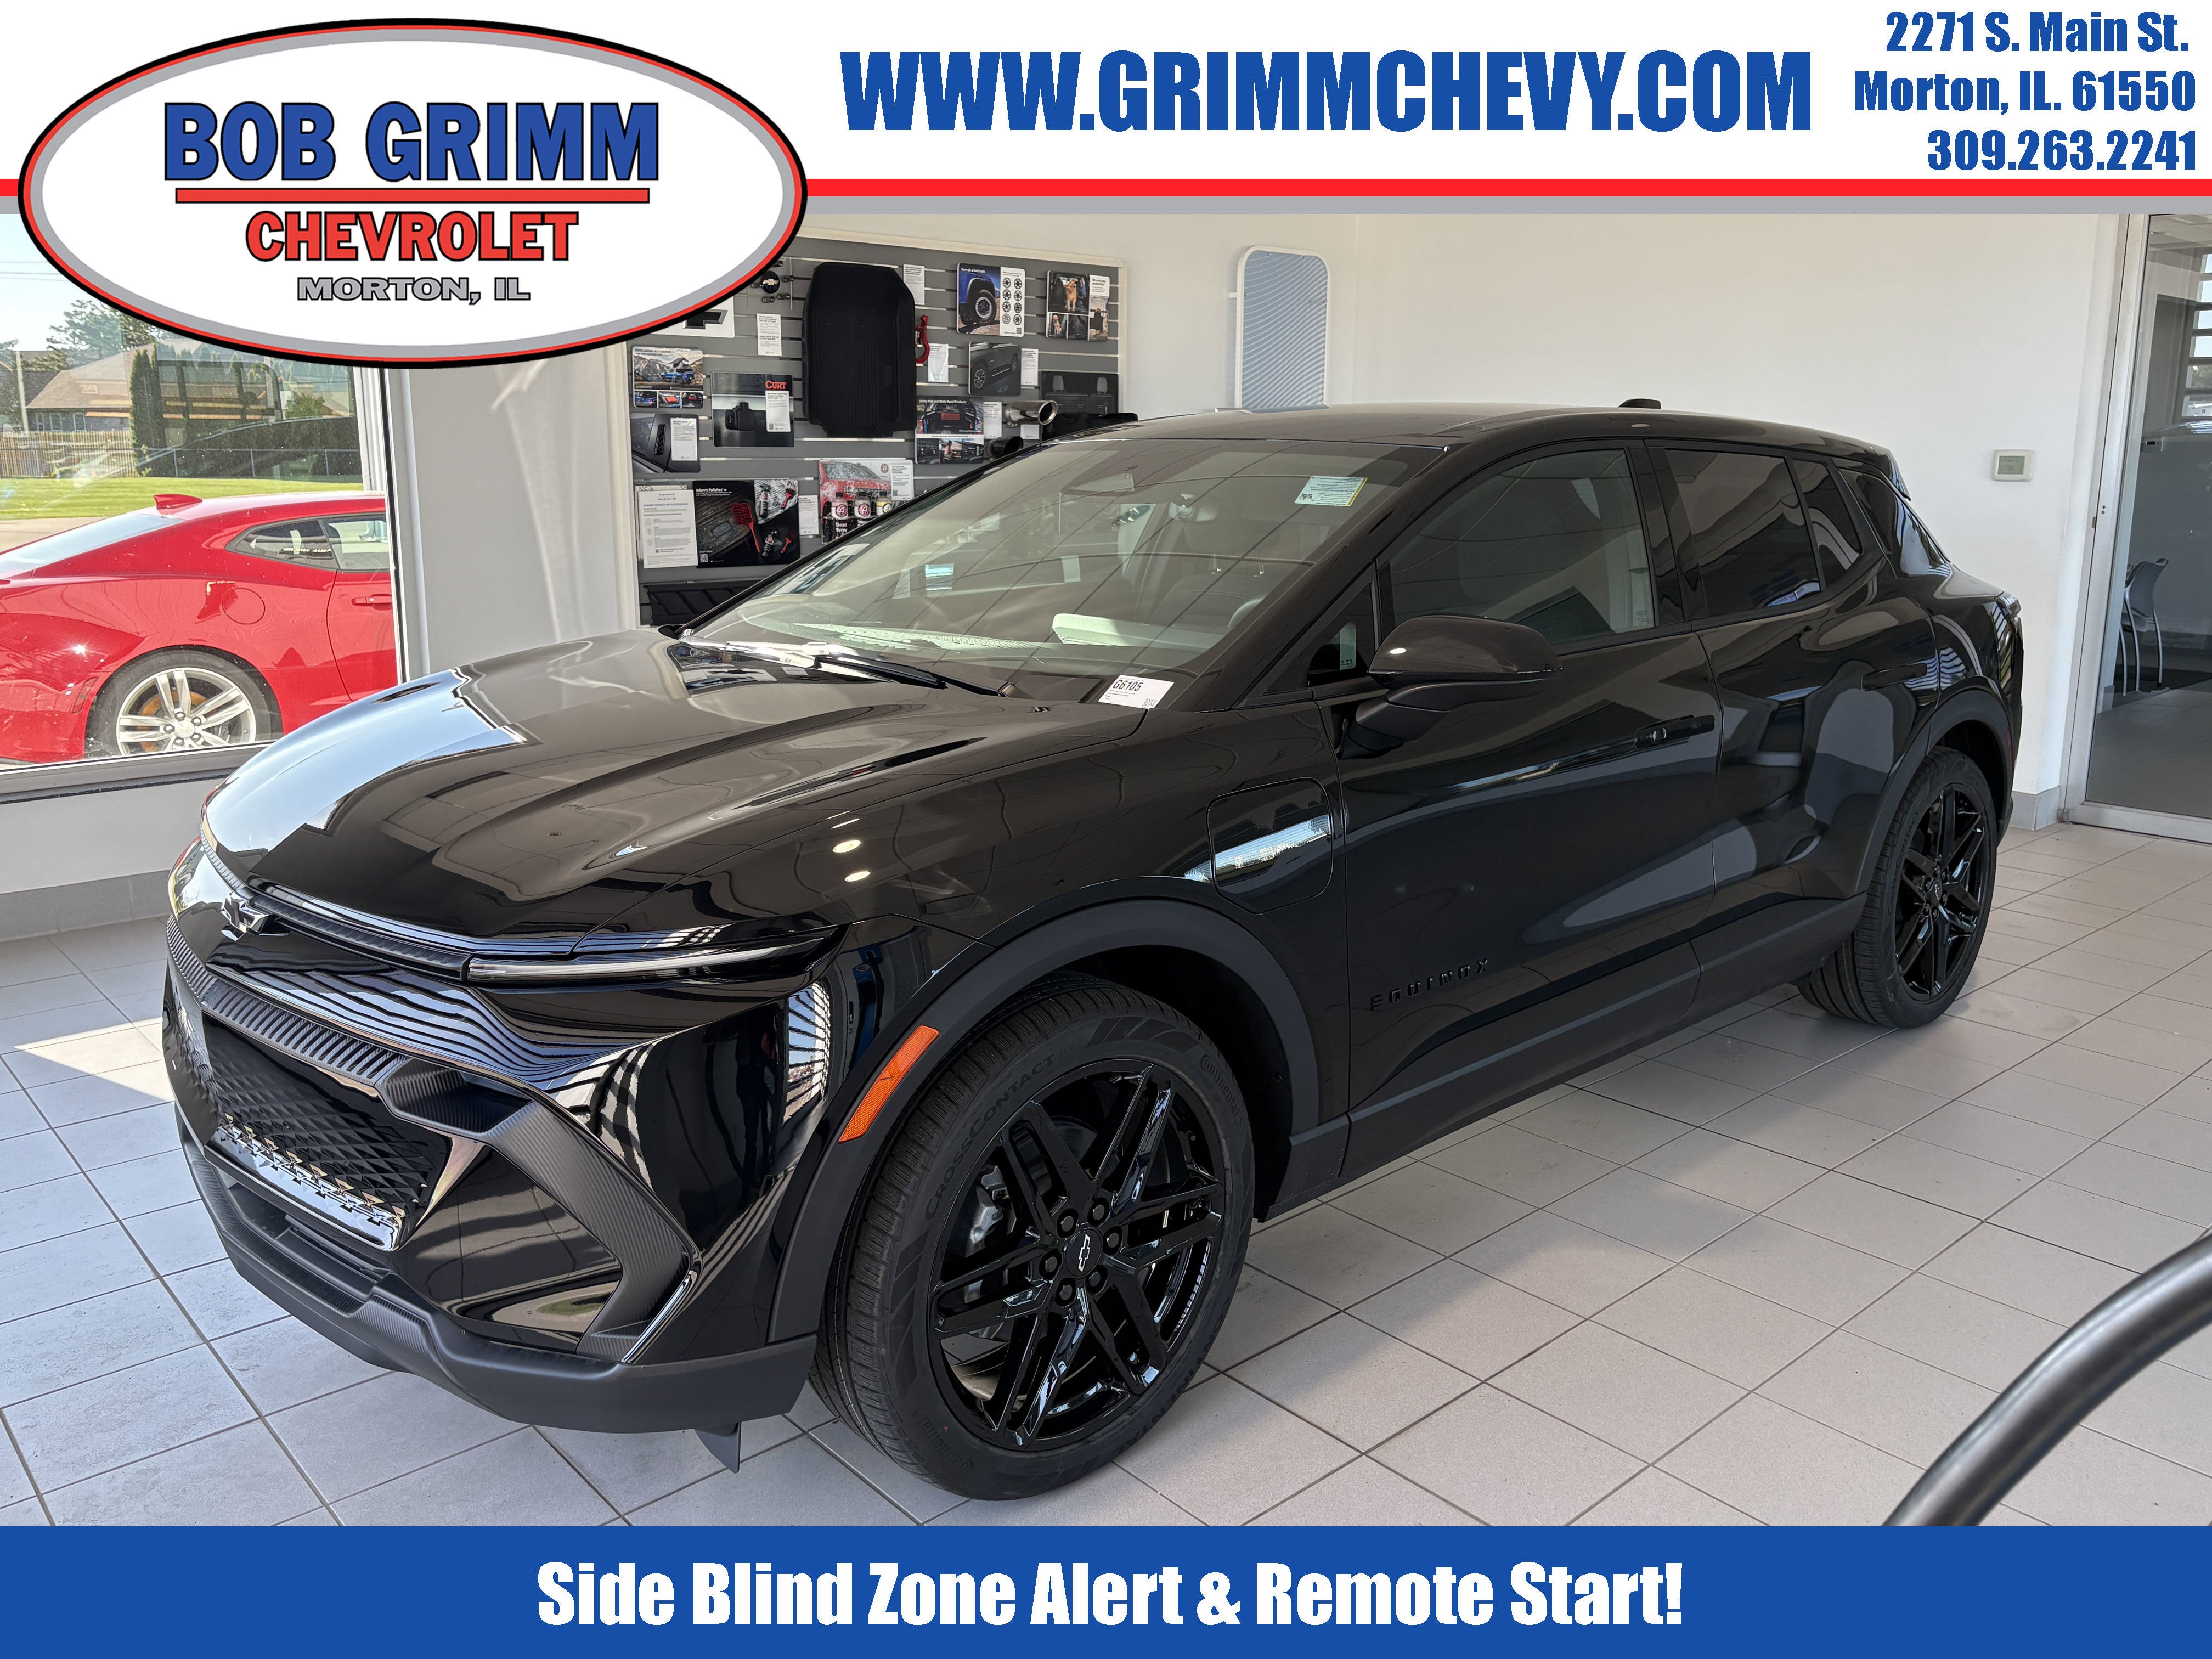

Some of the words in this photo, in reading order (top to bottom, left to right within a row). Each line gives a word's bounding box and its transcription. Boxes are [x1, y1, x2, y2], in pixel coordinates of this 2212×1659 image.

[765, 380, 787, 390] CURT
[1113, 679, 1144, 692] G6105
[1370, 958, 1488, 1011] EQUINOX
[1200, 1053, 1242, 1119] Continental
